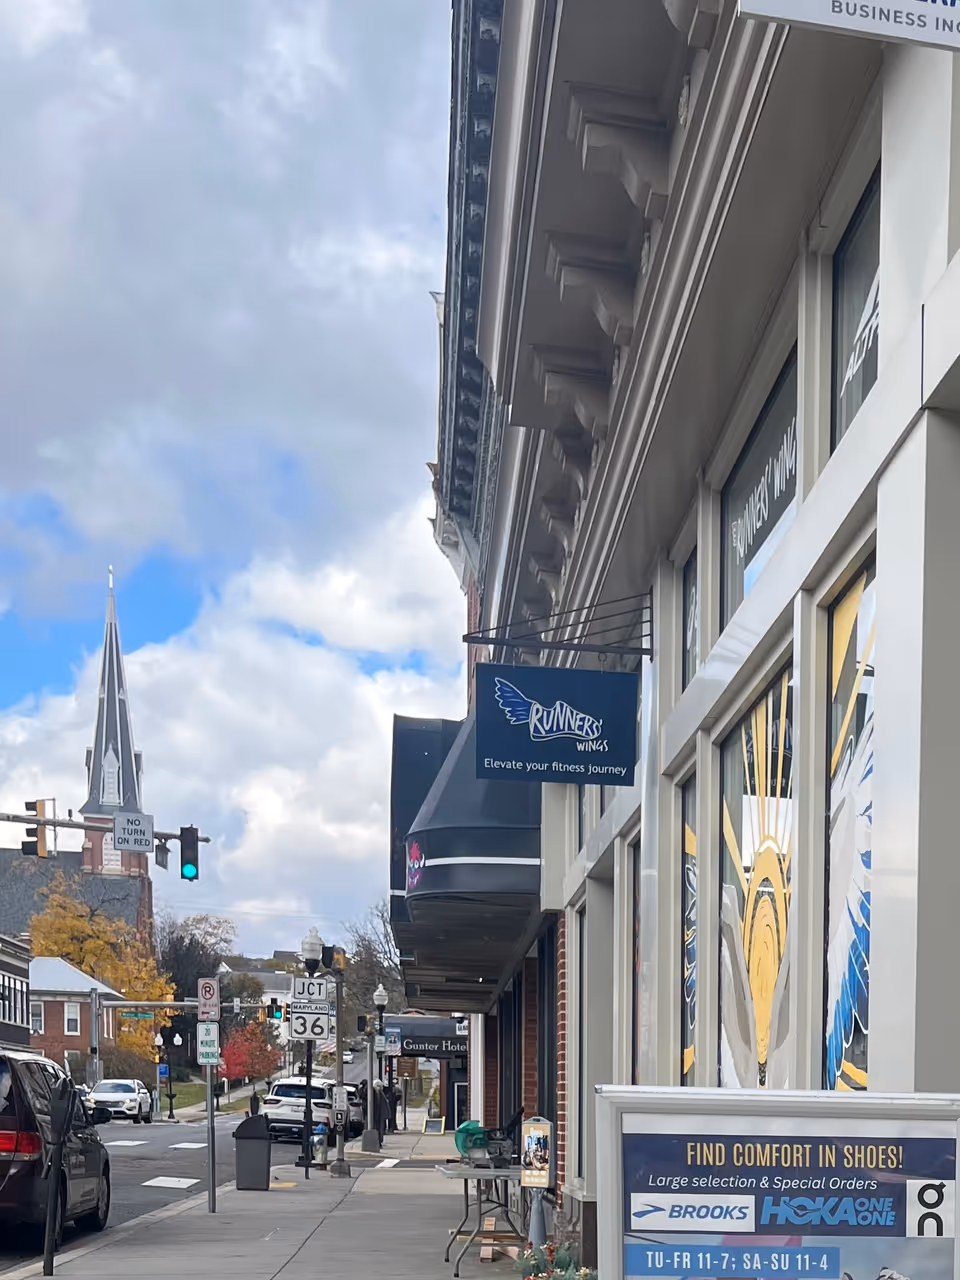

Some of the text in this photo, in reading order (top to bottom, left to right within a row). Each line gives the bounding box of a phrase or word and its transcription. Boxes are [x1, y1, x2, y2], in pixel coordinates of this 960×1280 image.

[831, 1, 928, 28] BUSINESS
[576, 740, 609, 752] WINGS
[484, 758, 627, 776] Elevate your fitness journey
[126, 818, 141, 827] NO
[121, 828, 146, 837] TURN
[117, 837, 151, 847] ON RED
[297, 982, 324, 997] JCT
[293, 1004, 328, 1012] MARYLAND
[293, 1015, 325, 1036] 36
[403, 1039, 439, 1050] Gunter
[686, 1142, 903, 1169] FIND COMFORT IN SHOES!
[648, 1174, 878, 1191] Large selection & Special Orders
[668, 1204, 750, 1220] BROOKS
[760, 1196, 857, 1226] HOKA
[854, 1197, 894, 1212] ONE
[857, 1211, 896, 1226] ONE
[646, 1251, 829, 1271] TU-FR 11-7; SA-SU 11-4
